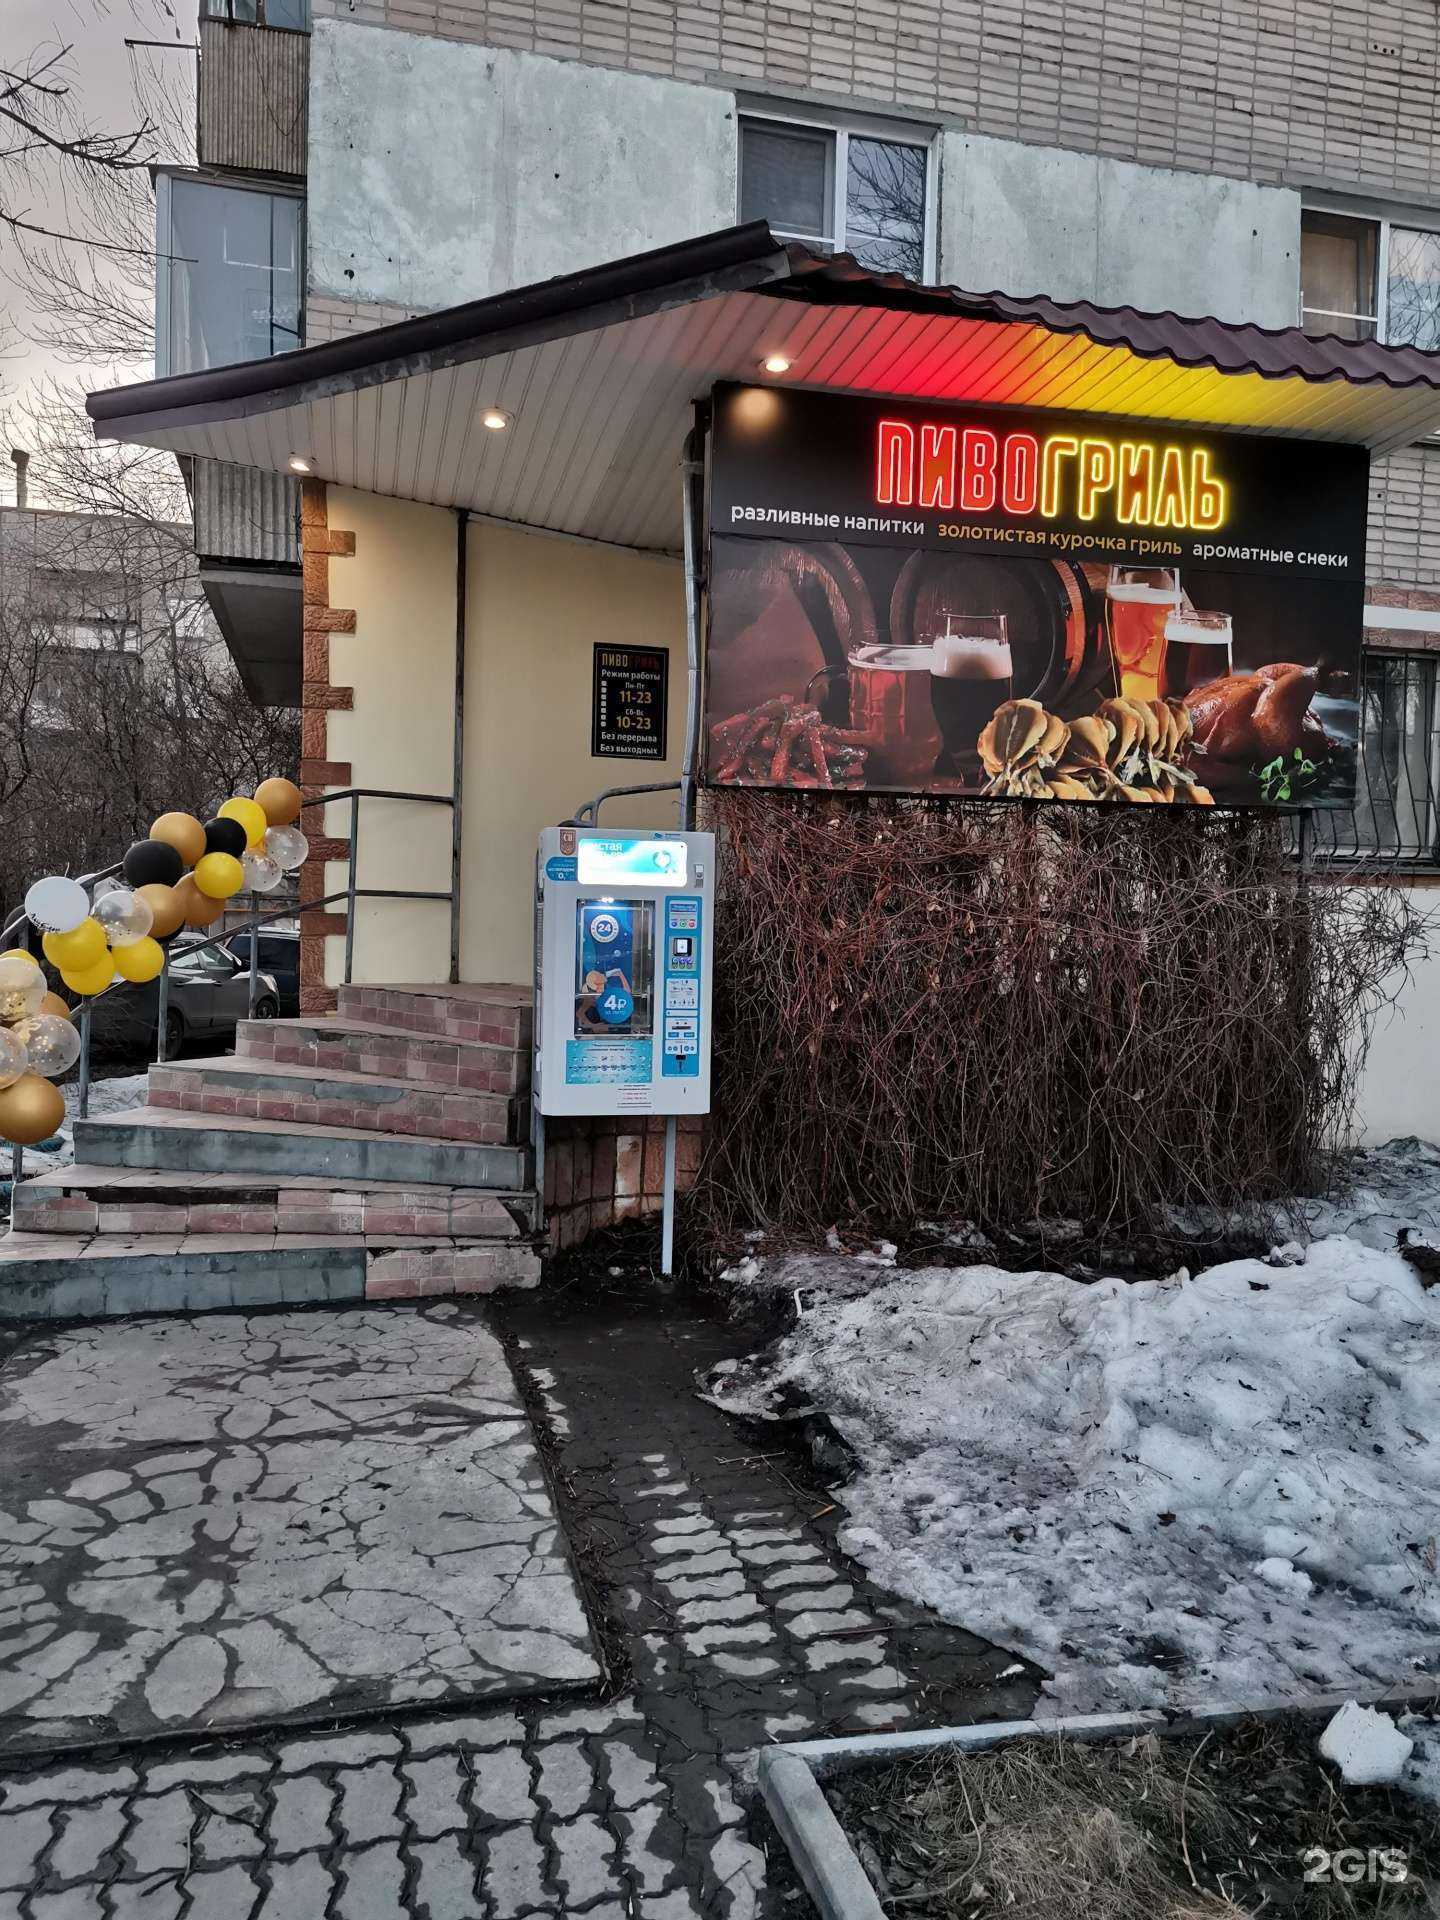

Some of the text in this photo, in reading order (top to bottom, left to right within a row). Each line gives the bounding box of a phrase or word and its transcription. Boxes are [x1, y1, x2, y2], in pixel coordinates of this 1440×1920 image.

[876, 420, 1225, 530] ПИВОГРИЛЬ
[731, 505, 1349, 568] разливные напитки золотистая курочка гриль ароматные снеки
[601, 669, 661, 680] Режим работы
[619, 690, 652, 704] 11-23
[616, 715, 652, 730] 10-23
[601, 732, 616, 740] Без
[600, 744, 615, 752] Без
[597, 923, 612, 933] 24
